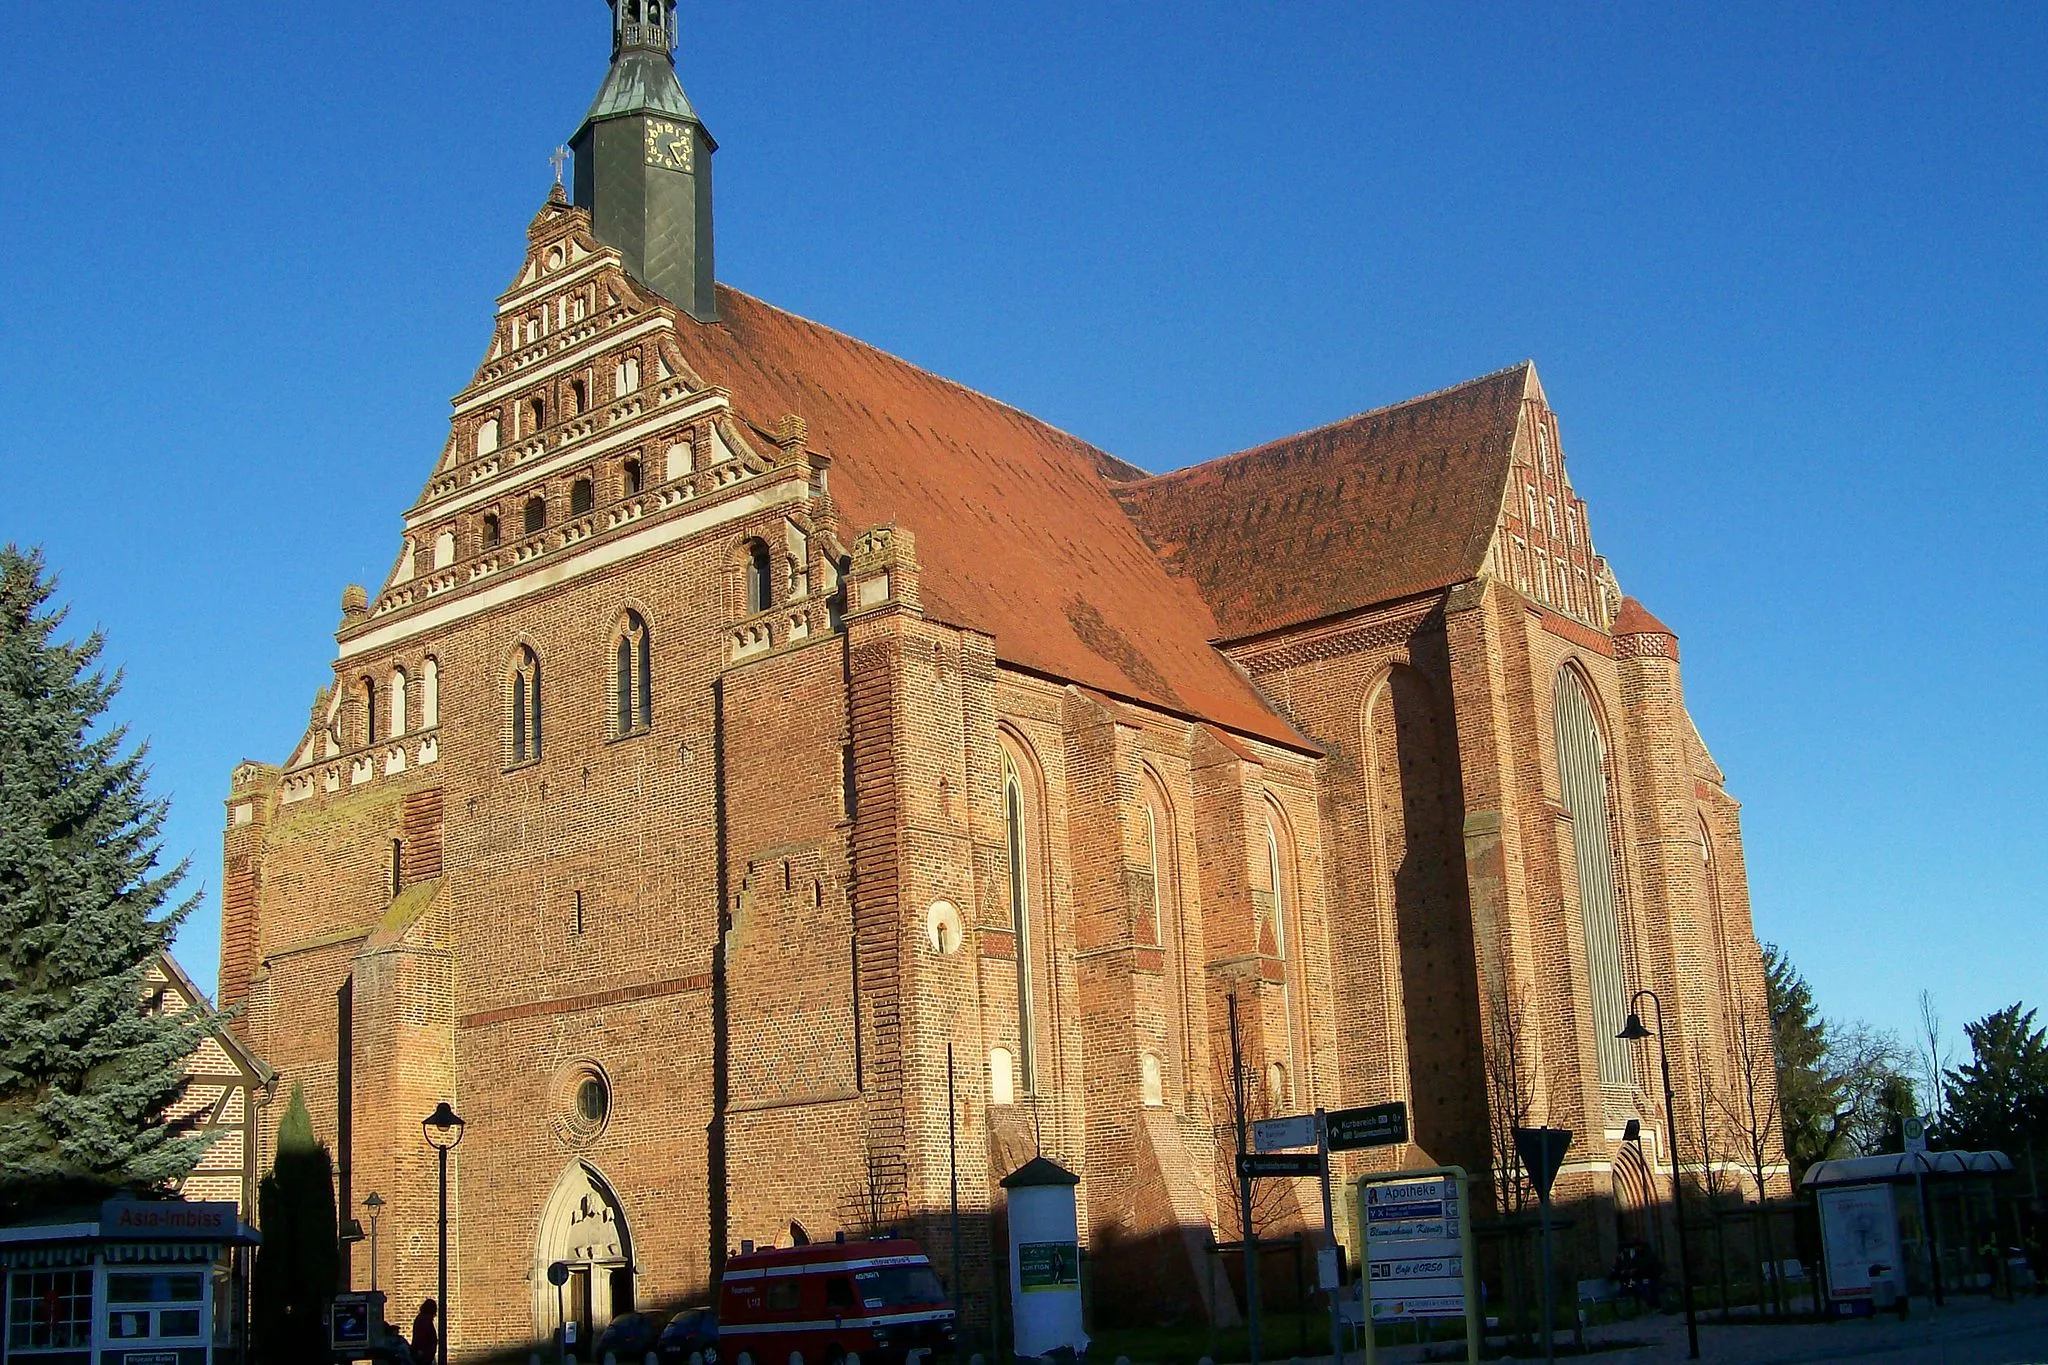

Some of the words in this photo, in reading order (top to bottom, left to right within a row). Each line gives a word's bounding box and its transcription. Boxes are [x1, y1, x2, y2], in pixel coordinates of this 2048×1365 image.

[648, 137, 655, 146] 9
[650, 146, 657, 155] 8
[656, 153, 664, 163] 7
[665, 157, 673, 168] 6
[1385, 1185, 1436, 1200] Apotheke
[119, 1208, 223, 1227] Asia-Imbiss
[1412, 1262, 1443, 1274] CORSO
